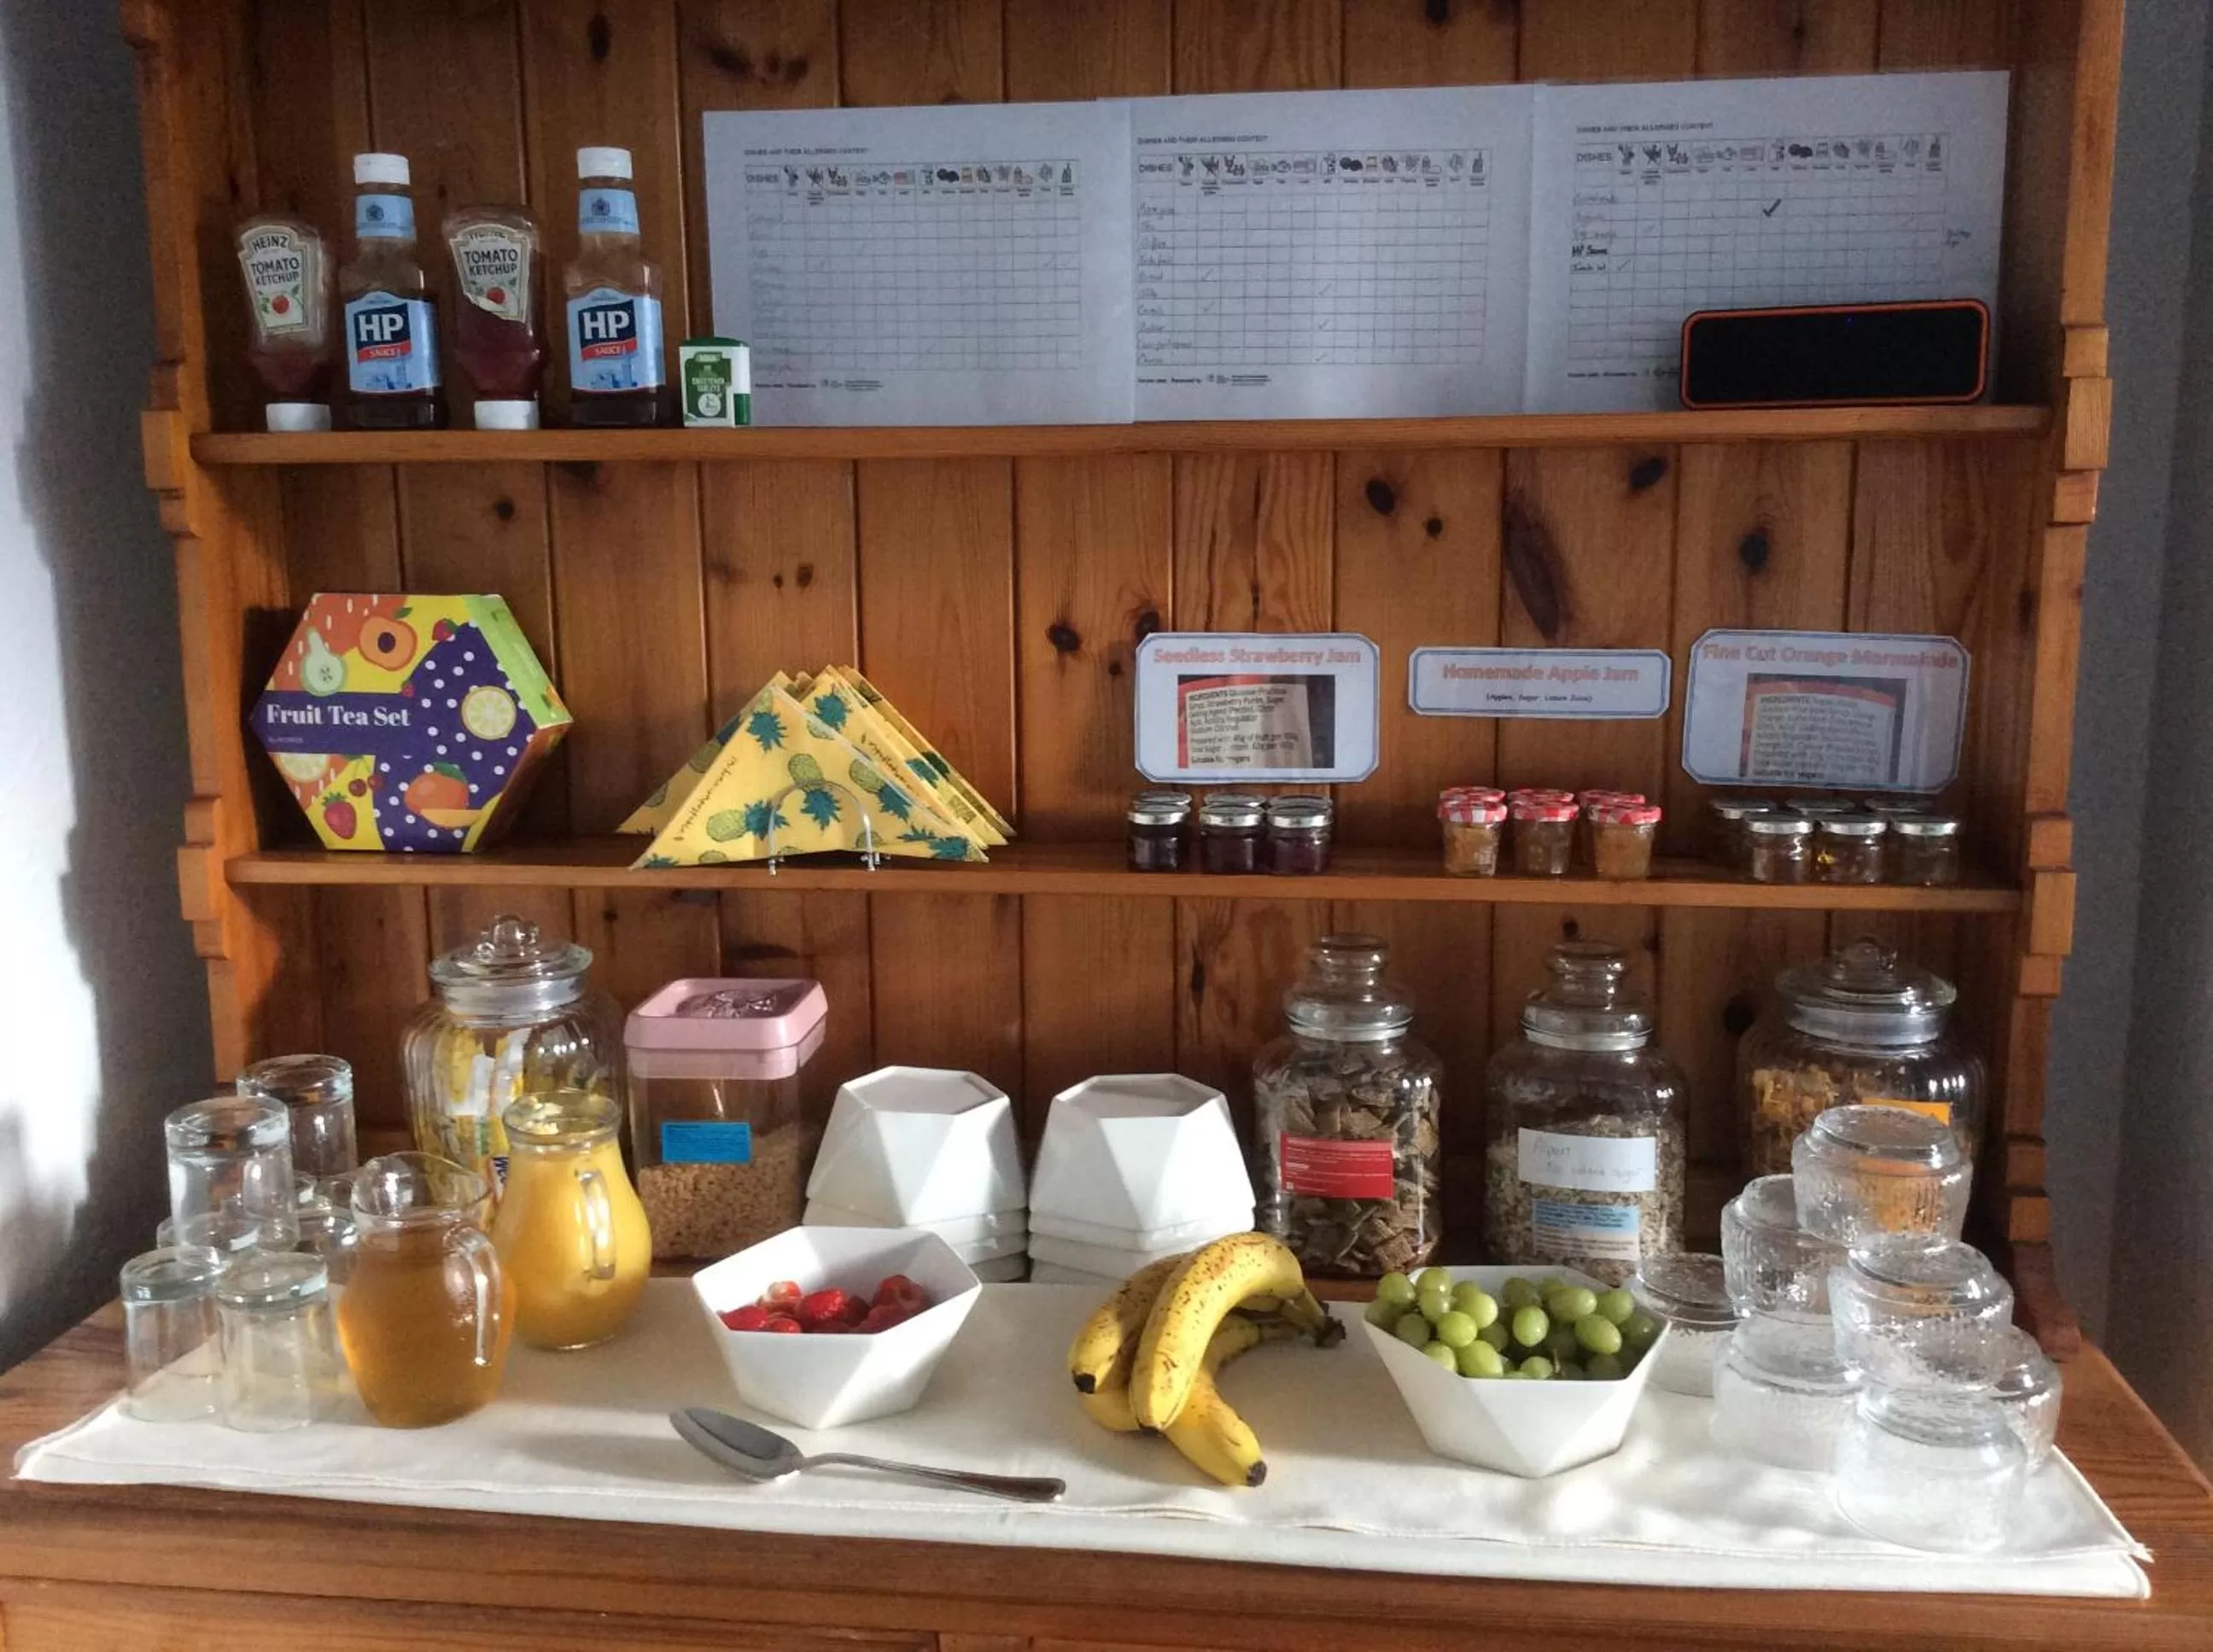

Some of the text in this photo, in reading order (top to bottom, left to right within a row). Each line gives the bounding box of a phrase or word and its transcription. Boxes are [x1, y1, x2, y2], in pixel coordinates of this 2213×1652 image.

[252, 235, 289, 251] HEINZ
[463, 248, 518, 264] TOMATO
[250, 257, 300, 275] TOMATO
[469, 263, 517, 277] KETCHUP
[255, 271, 300, 285] KETCHUP
[359, 313, 404, 341] HP
[582, 310, 630, 340] HP
[1154, 647, 1362, 666] Seedless Strawberry Jam
[1744, 645, 1777, 660] Cut
[1780, 646, 1848, 667] Orange
[1443, 663, 1639, 682] Homemade Apple Jam
[266, 703, 410, 726] Fruit Tea Set
